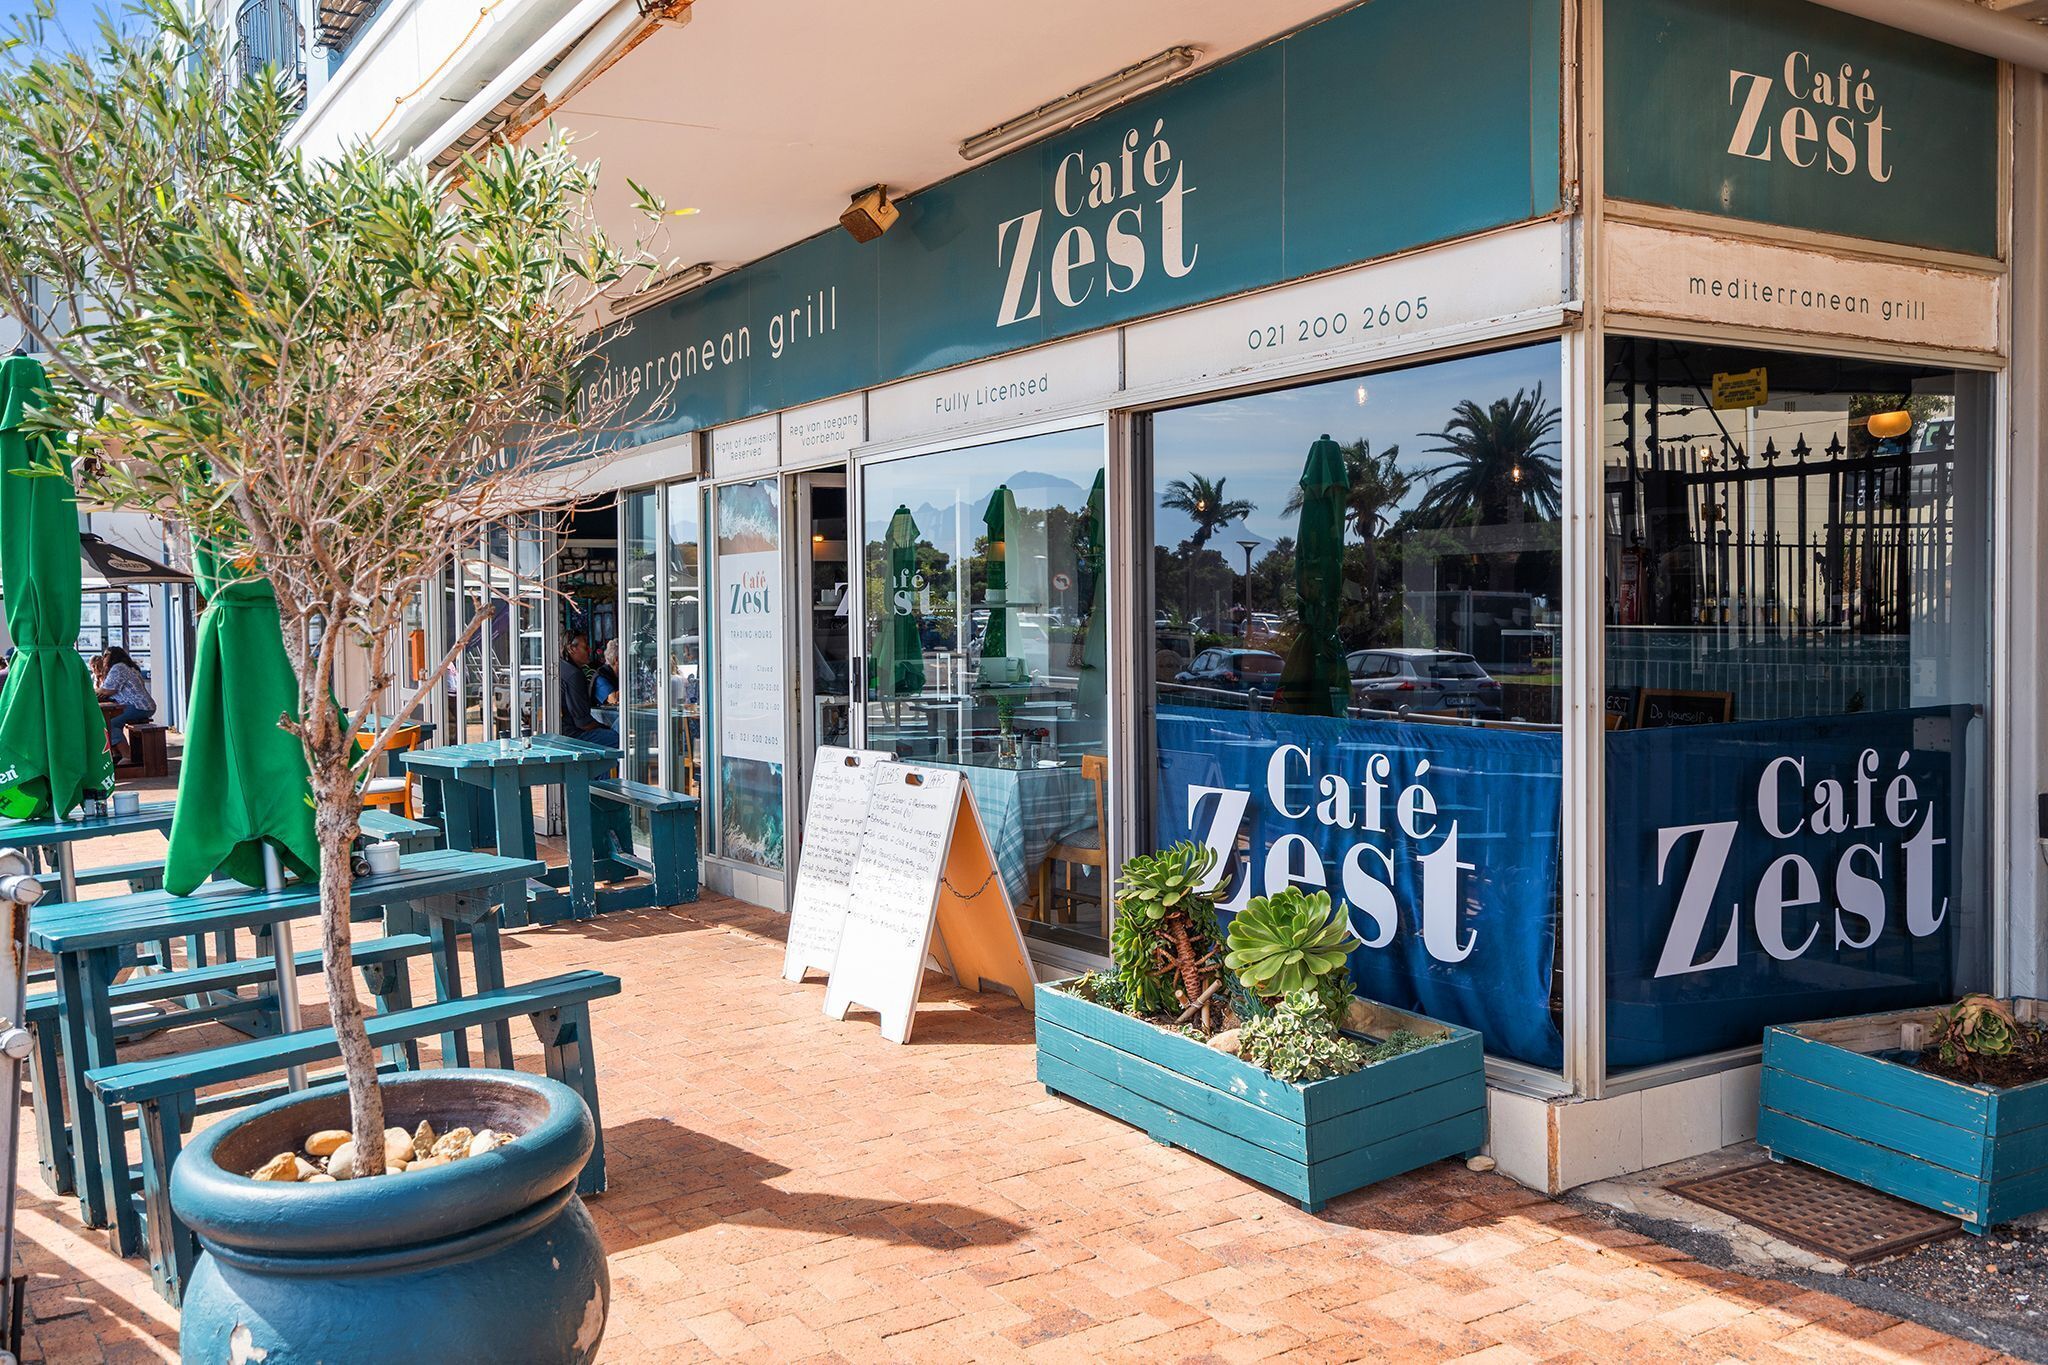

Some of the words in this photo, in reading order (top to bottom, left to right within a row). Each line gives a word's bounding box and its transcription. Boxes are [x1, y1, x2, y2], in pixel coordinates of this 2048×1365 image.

[1784, 50, 1875, 115] Café
[1727, 69, 1893, 183] Zest
[1054, 118, 1172, 218] Café
[995, 159, 1199, 328] Zest
[769, 285, 836, 359] grill
[1248, 324, 1285, 350] 021
[1298, 312, 1348, 342] 200
[1362, 296, 1429, 330] 2605
[1689, 276, 1869, 314] mediterranean
[1881, 299, 1926, 321] grill
[789, 425, 804, 437] Reg
[807, 420, 821, 432] van
[823, 413, 858, 429] toegang
[935, 392, 970, 414] Fully
[976, 372, 1048, 406] Licensed
[730, 446, 762, 462] Reserved
[801, 429, 845, 447] voorbehou
[730, 583, 771, 615] Zest
[742, 571, 766, 589] Café
[1267, 743, 1438, 840] Café
[1757, 747, 1919, 839] Café
[1187, 783, 1478, 964] Zest
[1653, 800, 1949, 979] Zest
